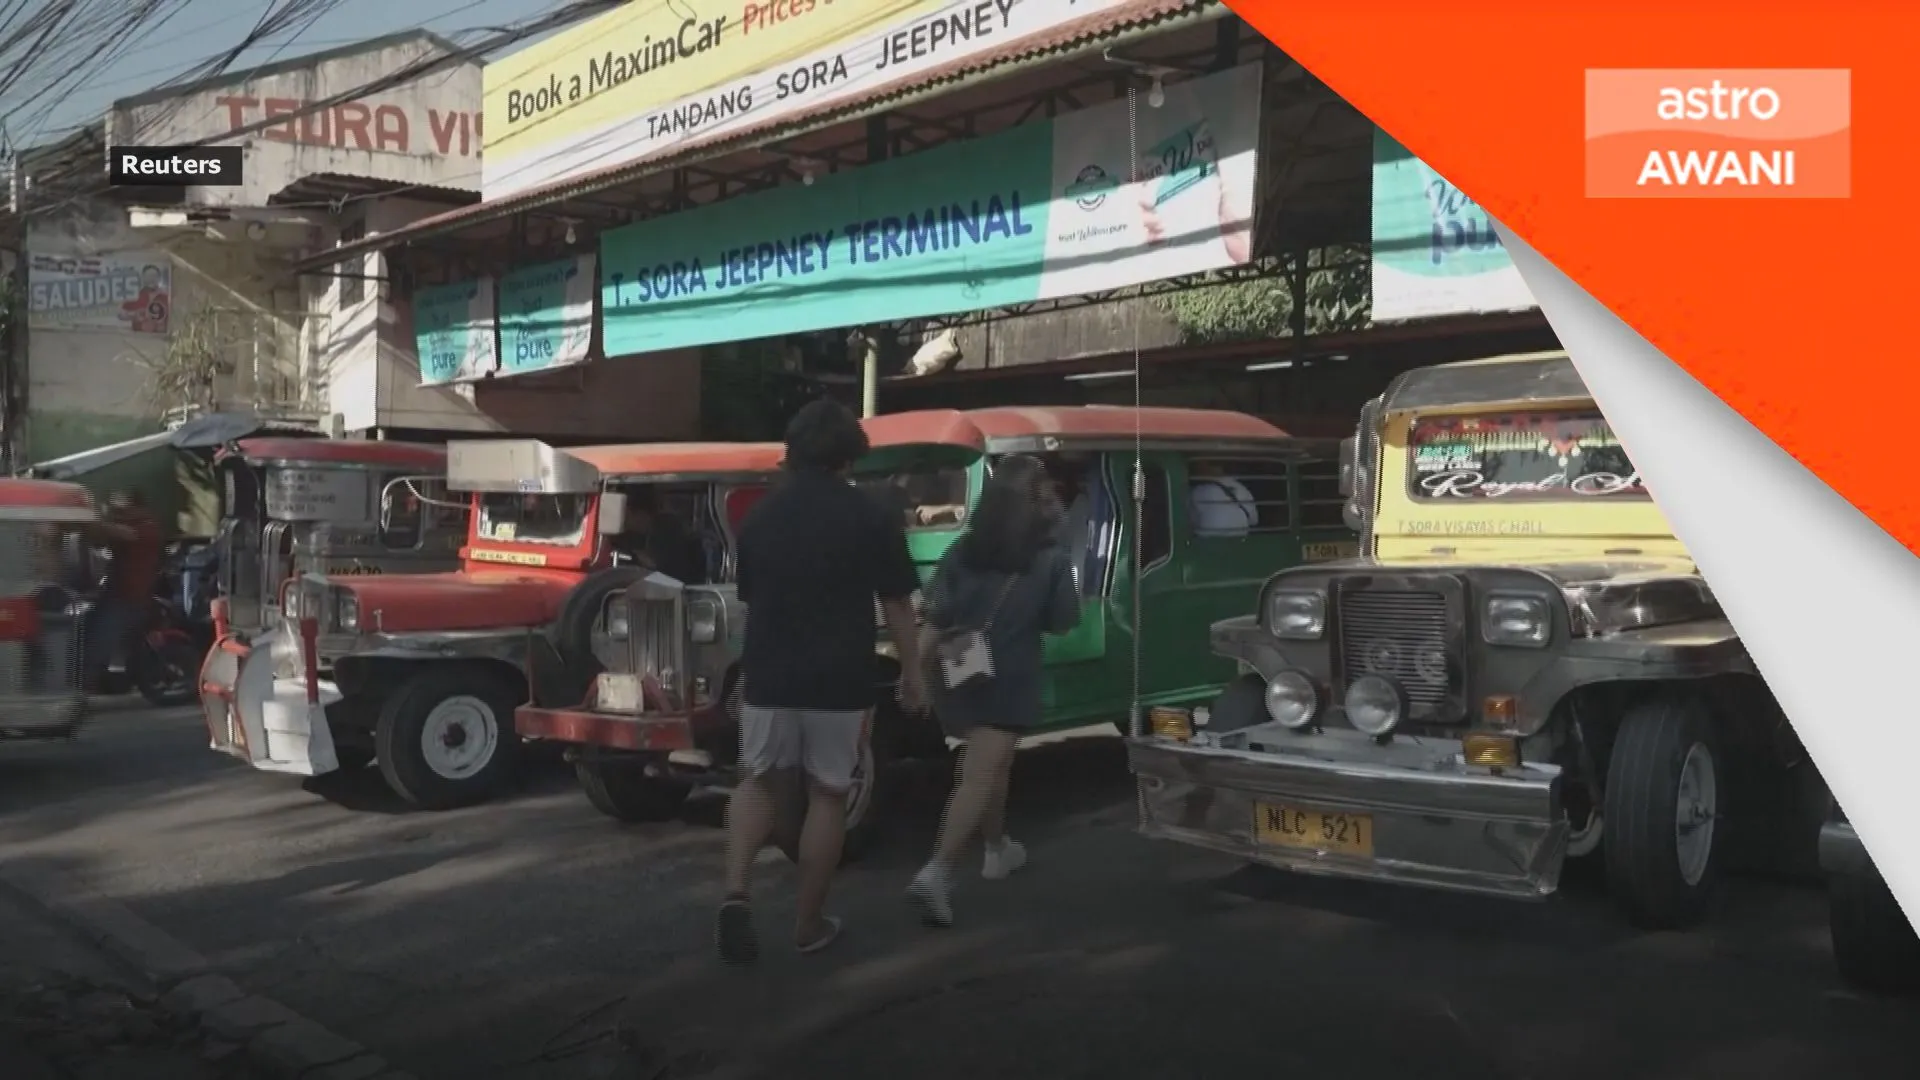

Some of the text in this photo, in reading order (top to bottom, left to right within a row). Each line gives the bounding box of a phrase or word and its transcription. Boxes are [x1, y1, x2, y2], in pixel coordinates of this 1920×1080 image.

[507, 73, 563, 124] Book
[568, 74, 582, 101] a
[588, 15, 726, 96] MaximCar
[647, 0, 1014, 142] TANDANG SORA JEEPNEY
[638, 256, 707, 302] SORA
[715, 229, 834, 290] JEEPNEY
[844, 190, 1033, 265] TERMINAL
[1431, 217, 1501, 265] pu
[32, 276, 139, 311] SALUDES
[148, 302, 165, 320] 9
[516, 338, 554, 366] pure
[1407, 519, 1440, 534] SORA
[1444, 519, 1494, 534] VISAYAS
[1266, 807, 1361, 845] NLC 521
